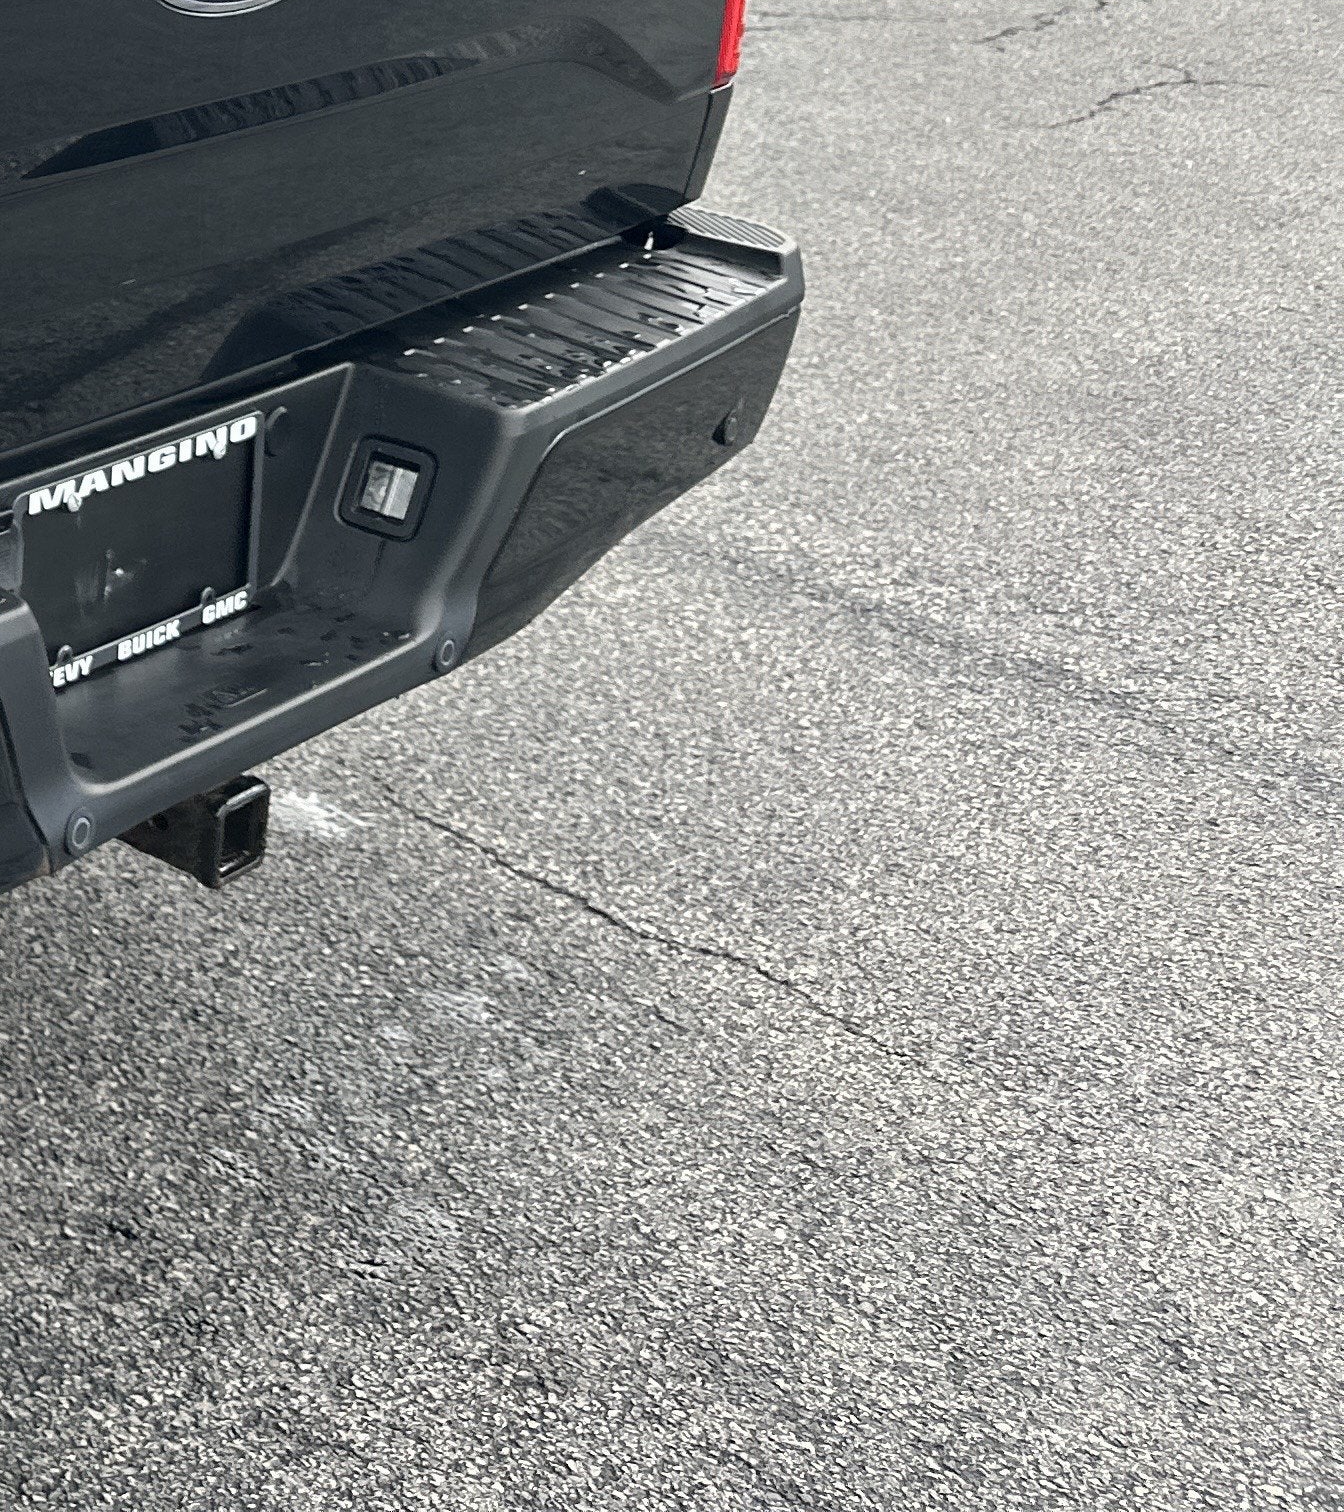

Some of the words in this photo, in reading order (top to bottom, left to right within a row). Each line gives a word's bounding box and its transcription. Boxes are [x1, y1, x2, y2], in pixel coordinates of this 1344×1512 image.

[28, 416, 259, 516] MANGINO
[49, 654, 94, 688] EVY
[117, 619, 181, 662] BUICK
[201, 590, 249, 626] GMC
